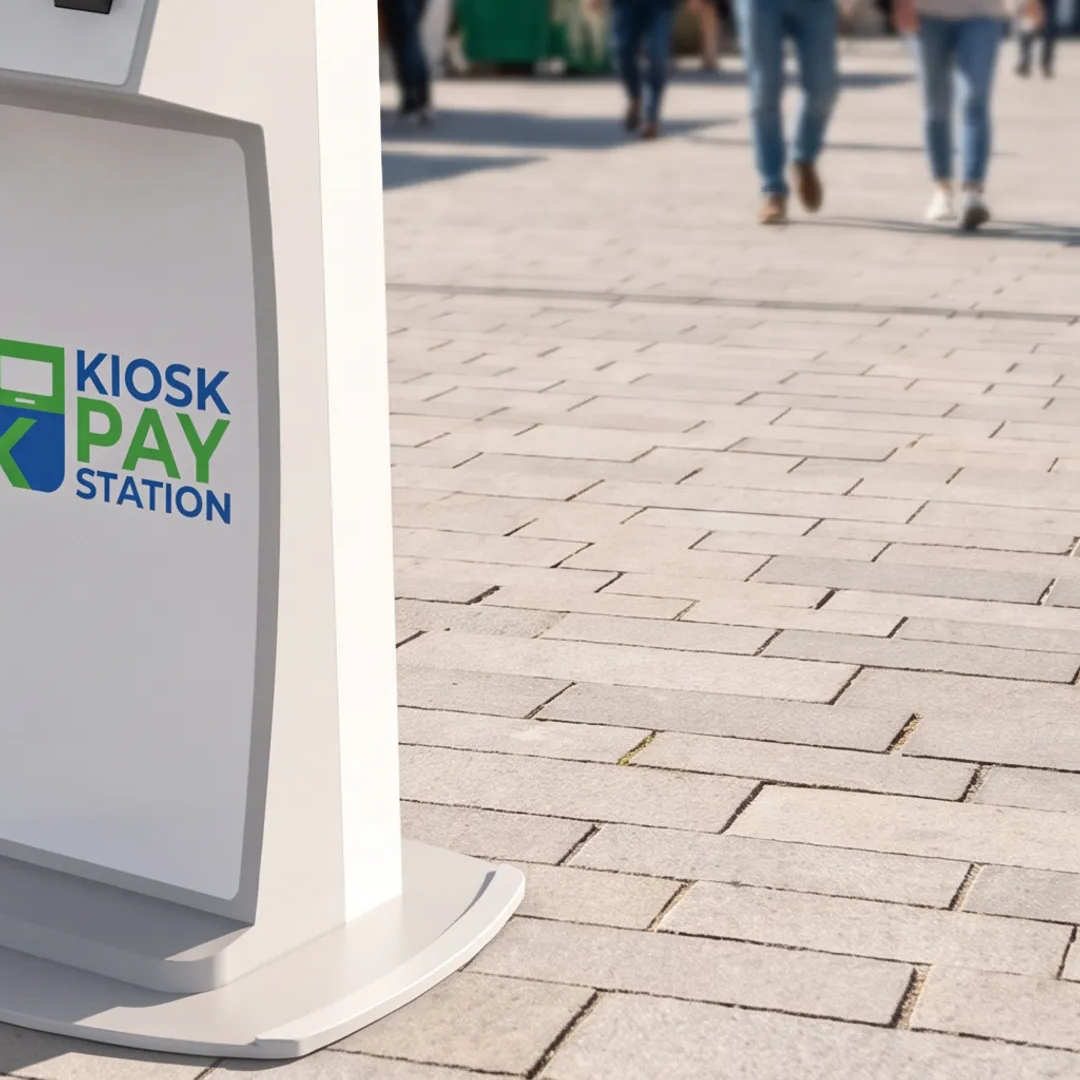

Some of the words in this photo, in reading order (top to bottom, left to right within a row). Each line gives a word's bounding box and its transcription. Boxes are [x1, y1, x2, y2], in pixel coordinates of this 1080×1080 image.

[76, 349, 231, 416] KIOSK
[76, 396, 231, 484] PAY
[75, 467, 231, 525] STATION
